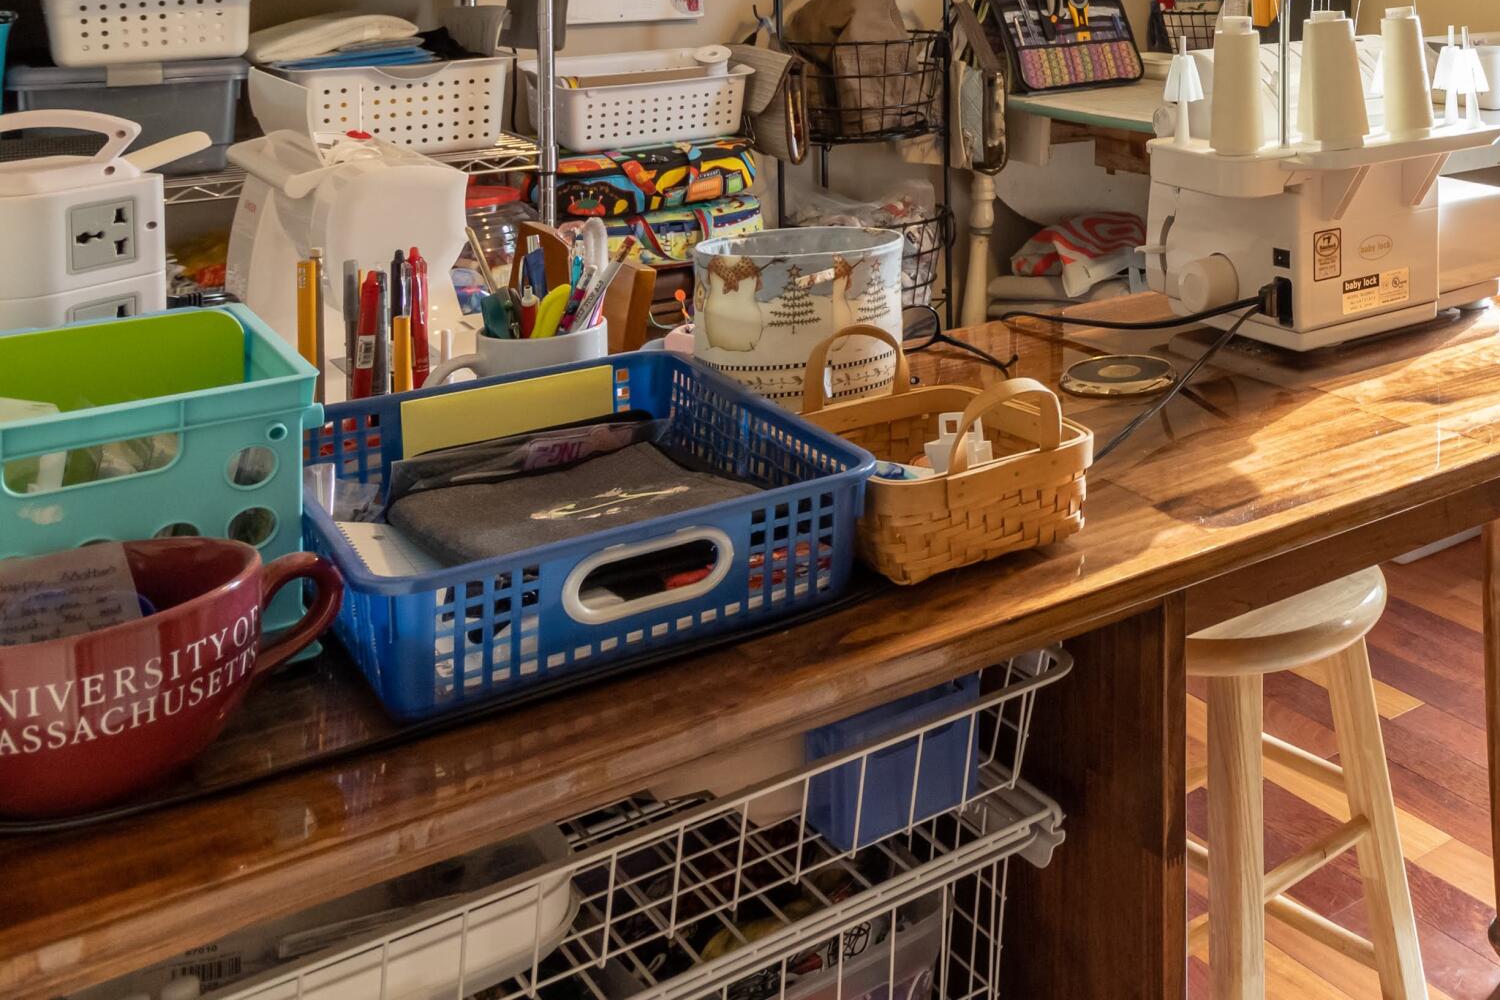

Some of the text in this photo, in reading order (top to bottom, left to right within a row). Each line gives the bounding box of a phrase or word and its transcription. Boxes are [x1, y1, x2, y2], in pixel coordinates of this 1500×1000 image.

[1344, 276, 1378, 291] baby lock
[232, 604, 260, 648] OF
